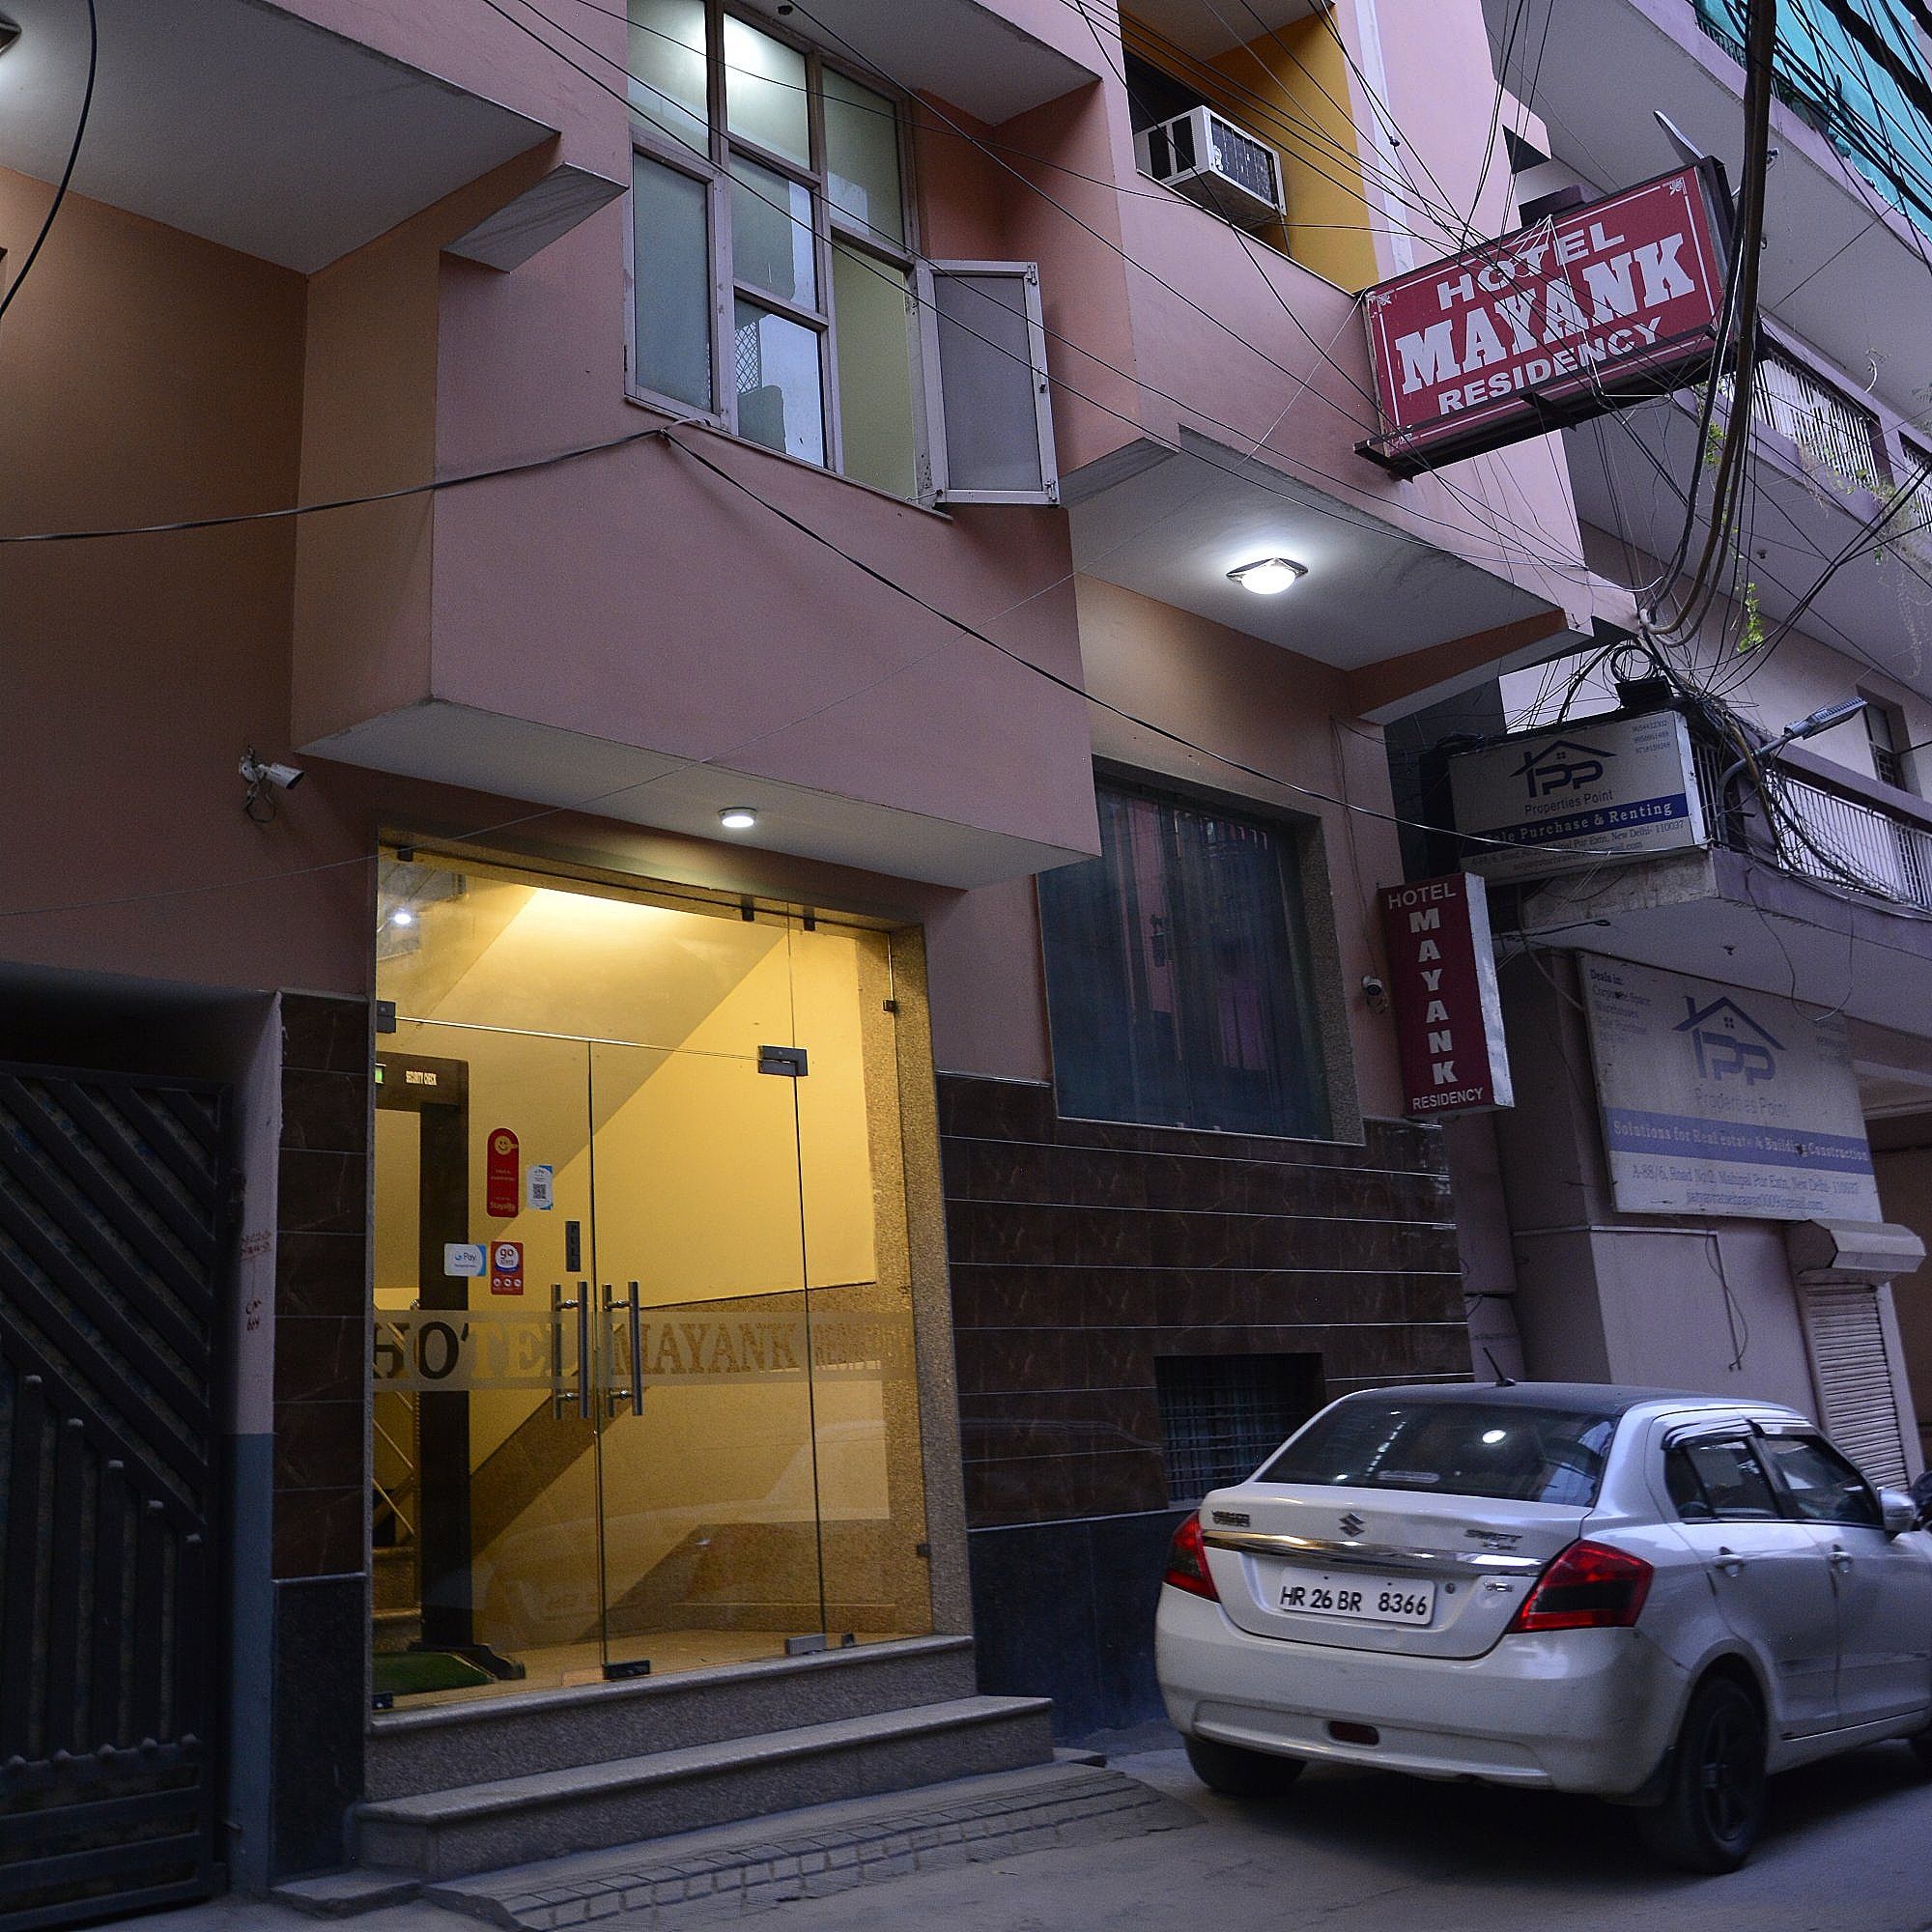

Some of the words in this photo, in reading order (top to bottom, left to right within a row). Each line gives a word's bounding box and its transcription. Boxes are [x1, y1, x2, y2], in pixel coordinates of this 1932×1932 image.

[1437, 222, 1625, 310] HOTEL
[1395, 233, 1694, 395] MAYANK
[1438, 316, 1662, 415] RESIDENCY
[1520, 817, 1590, 842] Purchase
[1594, 813, 1605, 827] &
[1609, 800, 1673, 824] Renting
[1524, 796, 1581, 817] Properties
[1584, 789, 1613, 807] Point
[1387, 883, 1457, 911] HOTEL
[1408, 907, 1459, 1086] MAYANK
[1412, 1087, 1484, 1111] RESIDENCY
[1613, 1120, 1670, 1141] Solutions
[1673, 1127, 1690, 1144] for
[1807, 1141, 1869, 1161] Construction
[1279, 1586, 1305, 1607] HR
[1311, 1588, 1332, 1609] 26
[1338, 1590, 1362, 1612] BR
[1378, 1591, 1427, 1616] 8366
